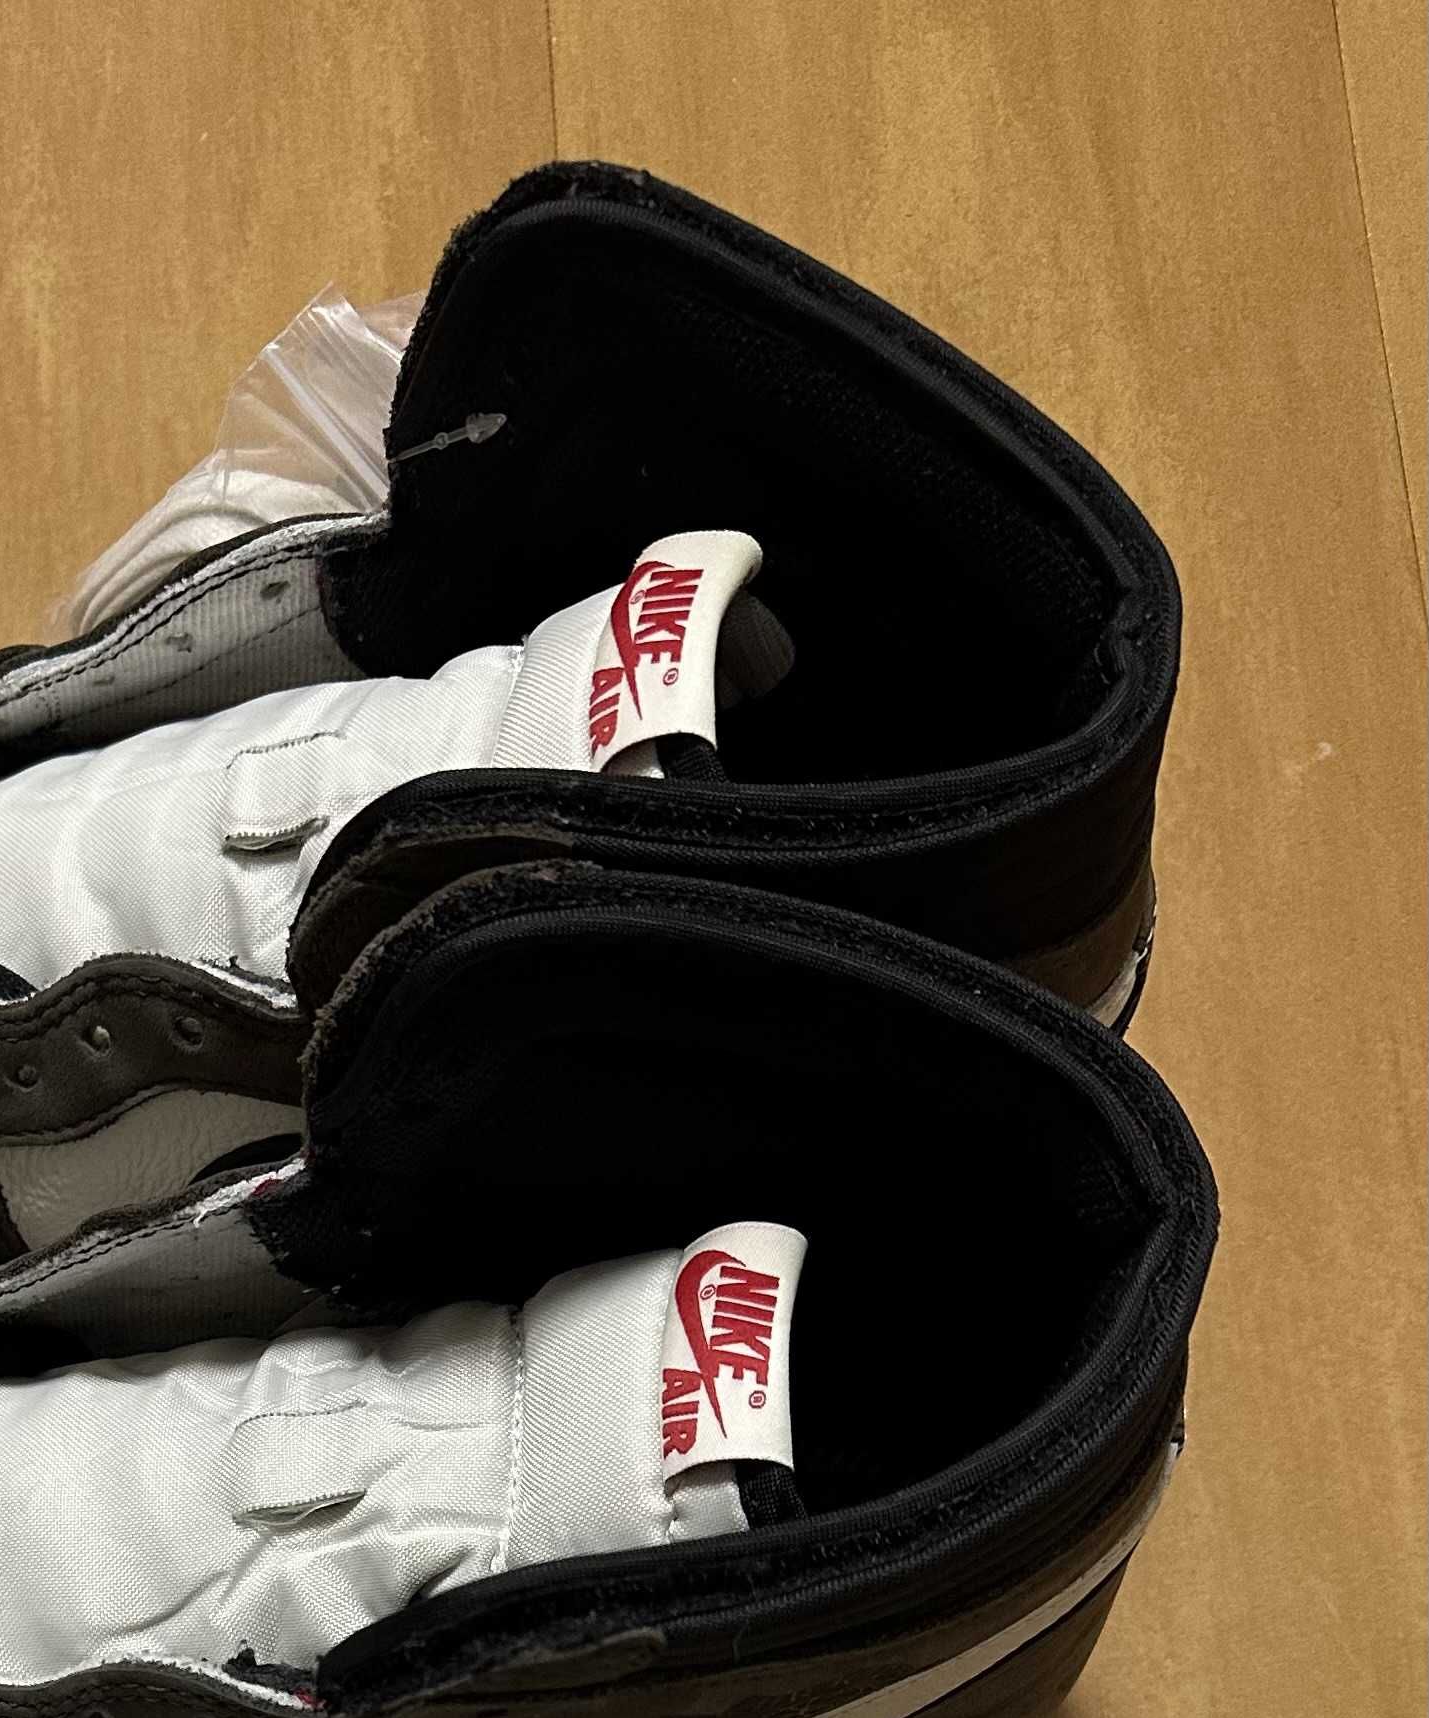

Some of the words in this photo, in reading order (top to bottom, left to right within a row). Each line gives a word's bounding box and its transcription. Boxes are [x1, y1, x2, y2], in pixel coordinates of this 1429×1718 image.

[634, 569, 704, 664] NIKE
[589, 667, 624, 760] AIR
[709, 1265, 780, 1386] NIKE
[662, 1368, 702, 1460] AIR
